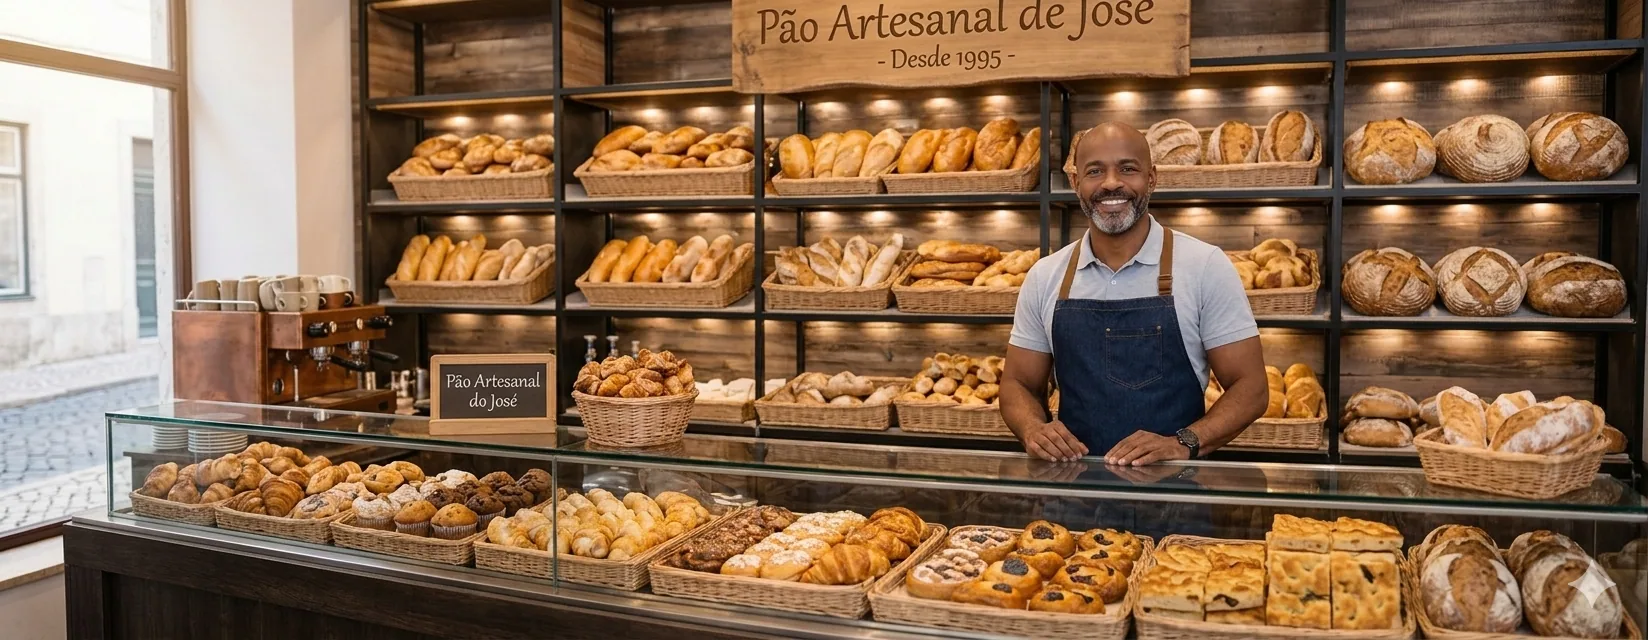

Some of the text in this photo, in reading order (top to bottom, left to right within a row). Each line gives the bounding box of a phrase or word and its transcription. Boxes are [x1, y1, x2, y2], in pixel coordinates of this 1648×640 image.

[757, 9, 819, 45] Pão
[827, 0, 1009, 41] Artesanal
[1019, 0, 1065, 31] de
[890, 43, 951, 69] Desde
[955, 49, 1002, 71] 1995
[473, 371, 541, 388] Artesanal
[469, 391, 518, 412] do José
